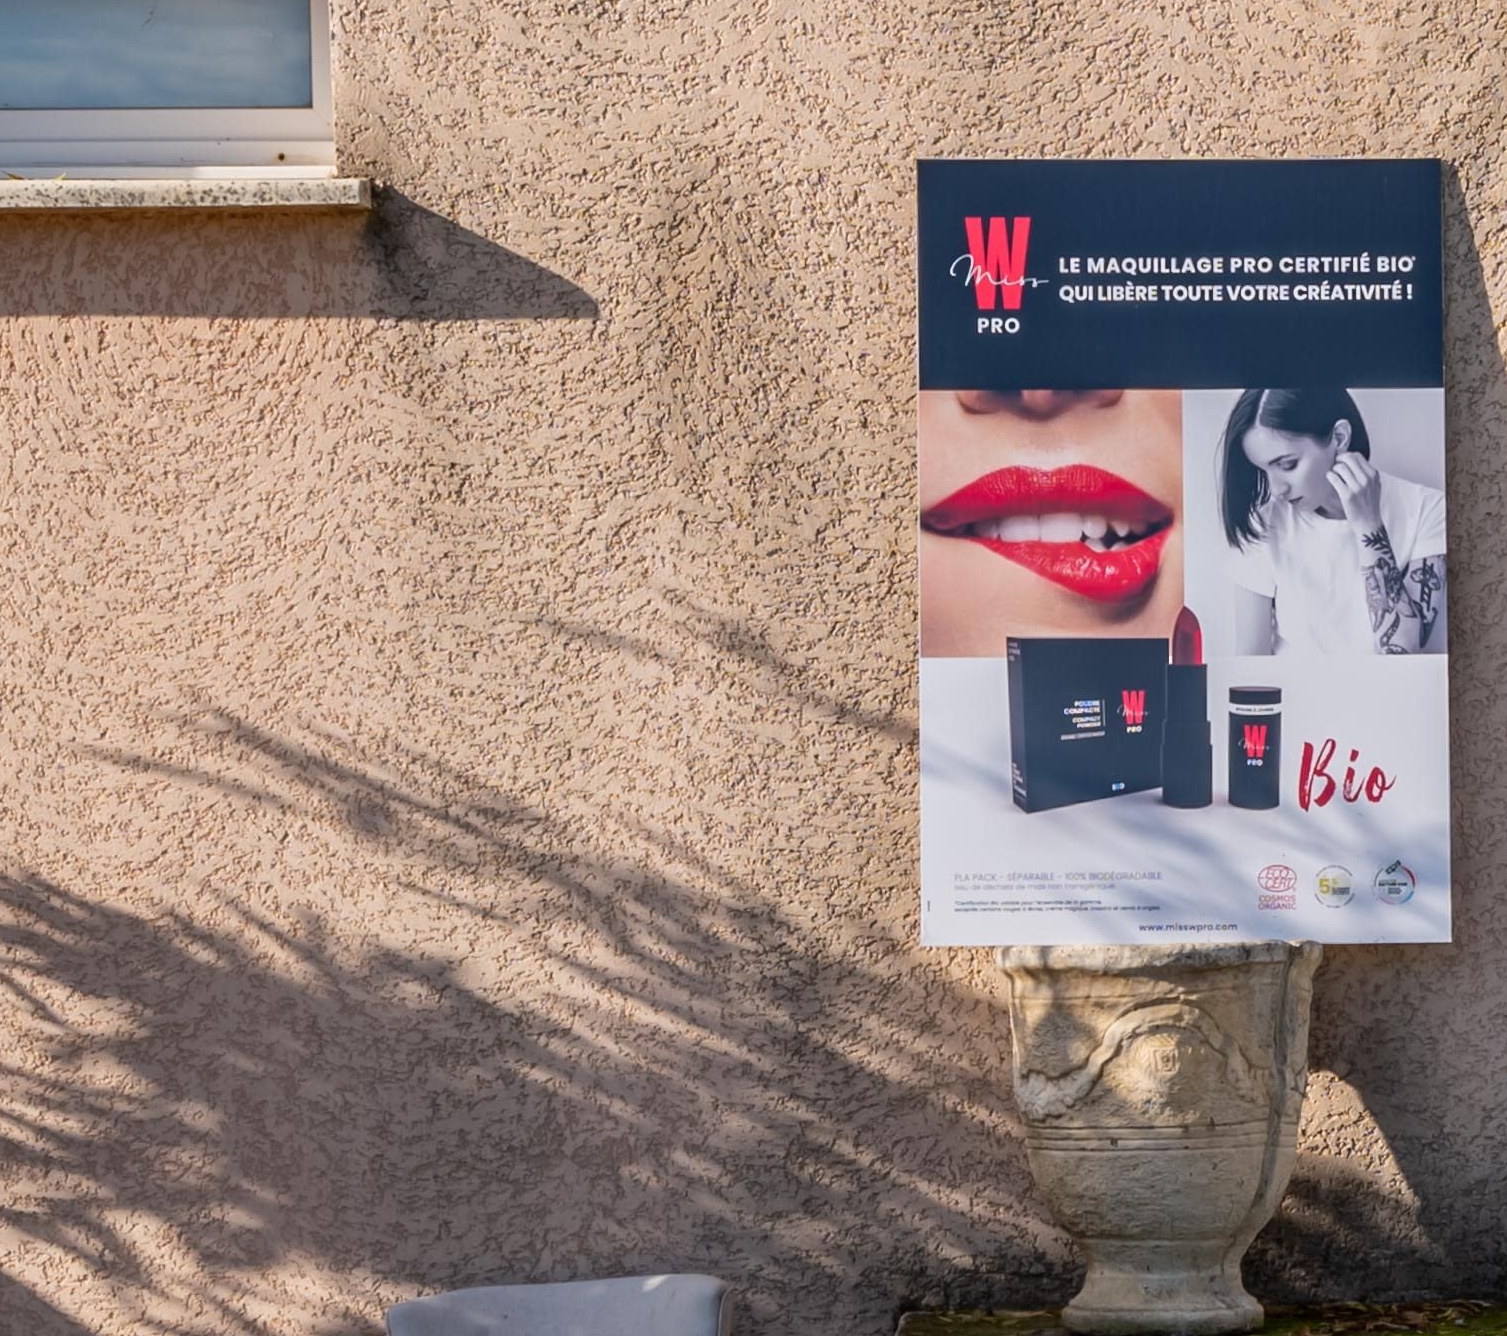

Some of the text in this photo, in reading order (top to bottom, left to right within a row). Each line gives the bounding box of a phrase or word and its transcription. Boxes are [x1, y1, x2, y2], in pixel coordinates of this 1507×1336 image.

[949, 216, 1050, 310] Miss W
[1059, 257, 1081, 274] LE
[1087, 256, 1224, 275] MAQUILLAGE
[1230, 256, 1273, 274] PRO
[1279, 252, 1370, 274] CERTIFIÉ
[1059, 284, 1093, 303] QUI
[1098, 280, 1158, 302] LIBÈRE
[1161, 284, 1222, 302] TOUTE
[1226, 284, 1289, 301] VOTRE
[1293, 280, 1403, 301] CRÉATIVITÉ
[977, 318, 1020, 334] PRO
[1122, 690, 1146, 725] W
[1244, 725, 1267, 758] W
[1298, 738, 1397, 812] Bio
[954, 873, 970, 882] PLA
[972, 873, 997, 882] PACK
[1259, 894, 1296, 902] COSMOS
[1138, 922, 1238, 934] www.misswpro.com
